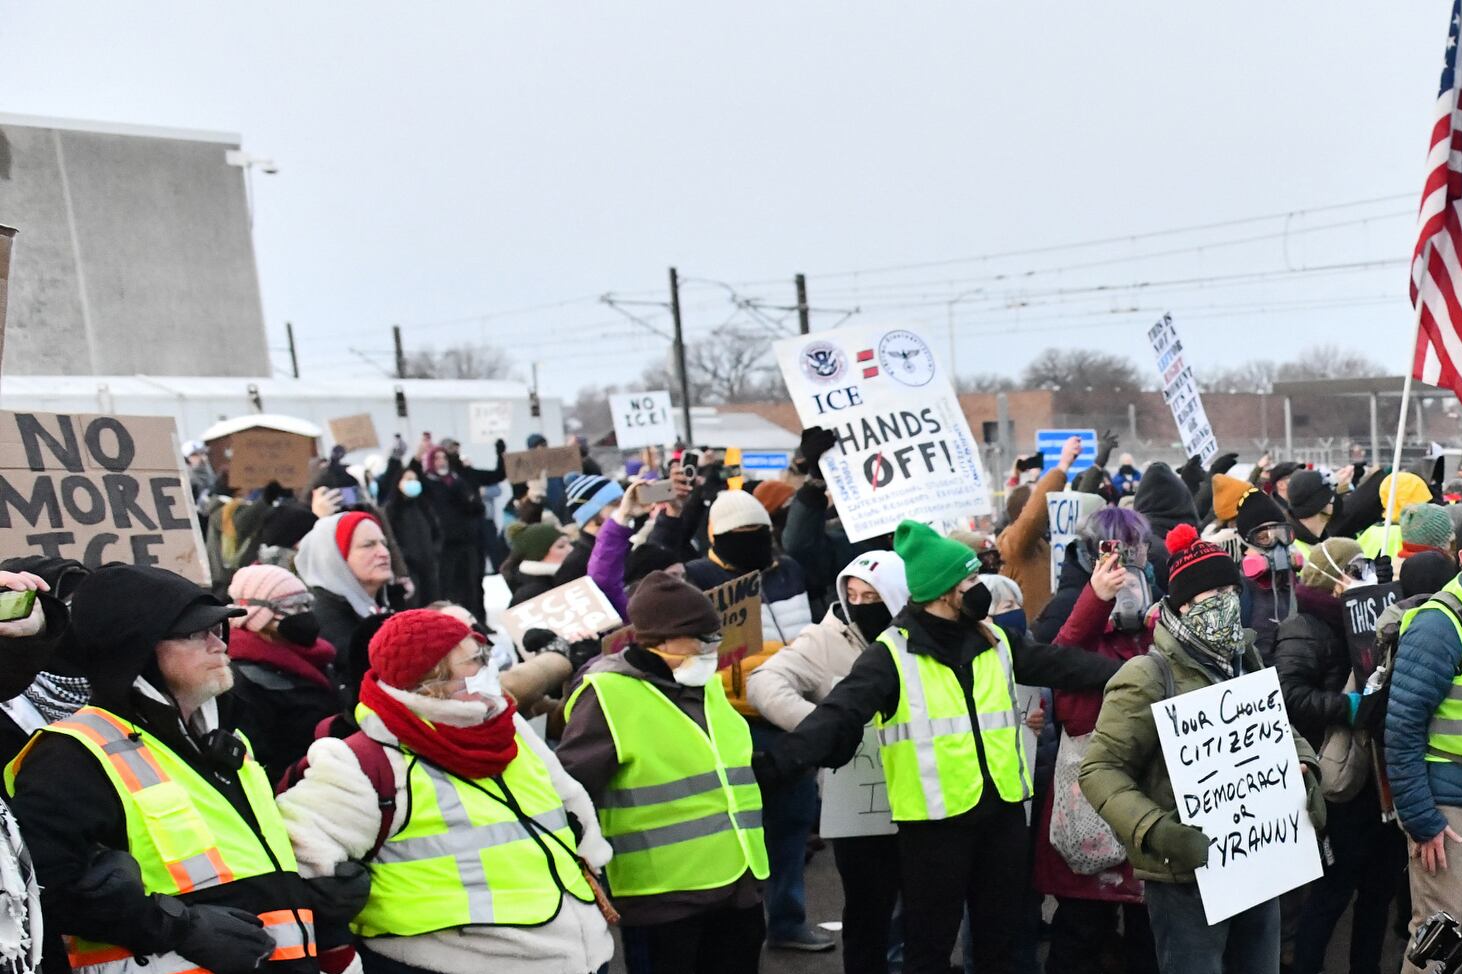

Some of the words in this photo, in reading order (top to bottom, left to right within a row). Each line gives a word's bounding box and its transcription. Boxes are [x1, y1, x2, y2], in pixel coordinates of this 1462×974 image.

[625, 407, 667, 427] ICE!
[631, 397, 655, 410] NO
[811, 386, 863, 414] ICE
[15, 413, 135, 473] NO
[834, 408, 941, 455] HANDS
[863, 440, 956, 488] OFF!
[0, 474, 192, 531] MORE
[511, 585, 587, 629] ICE
[1346, 597, 1377, 634] THIS
[1165, 704, 1214, 737] YOUR
[1220, 690, 1282, 725] CHOICE,
[1180, 720, 1290, 765] CITIZENS:
[1184, 760, 1289, 818] DEMOCRACY
[1233, 804, 1256, 824] OR
